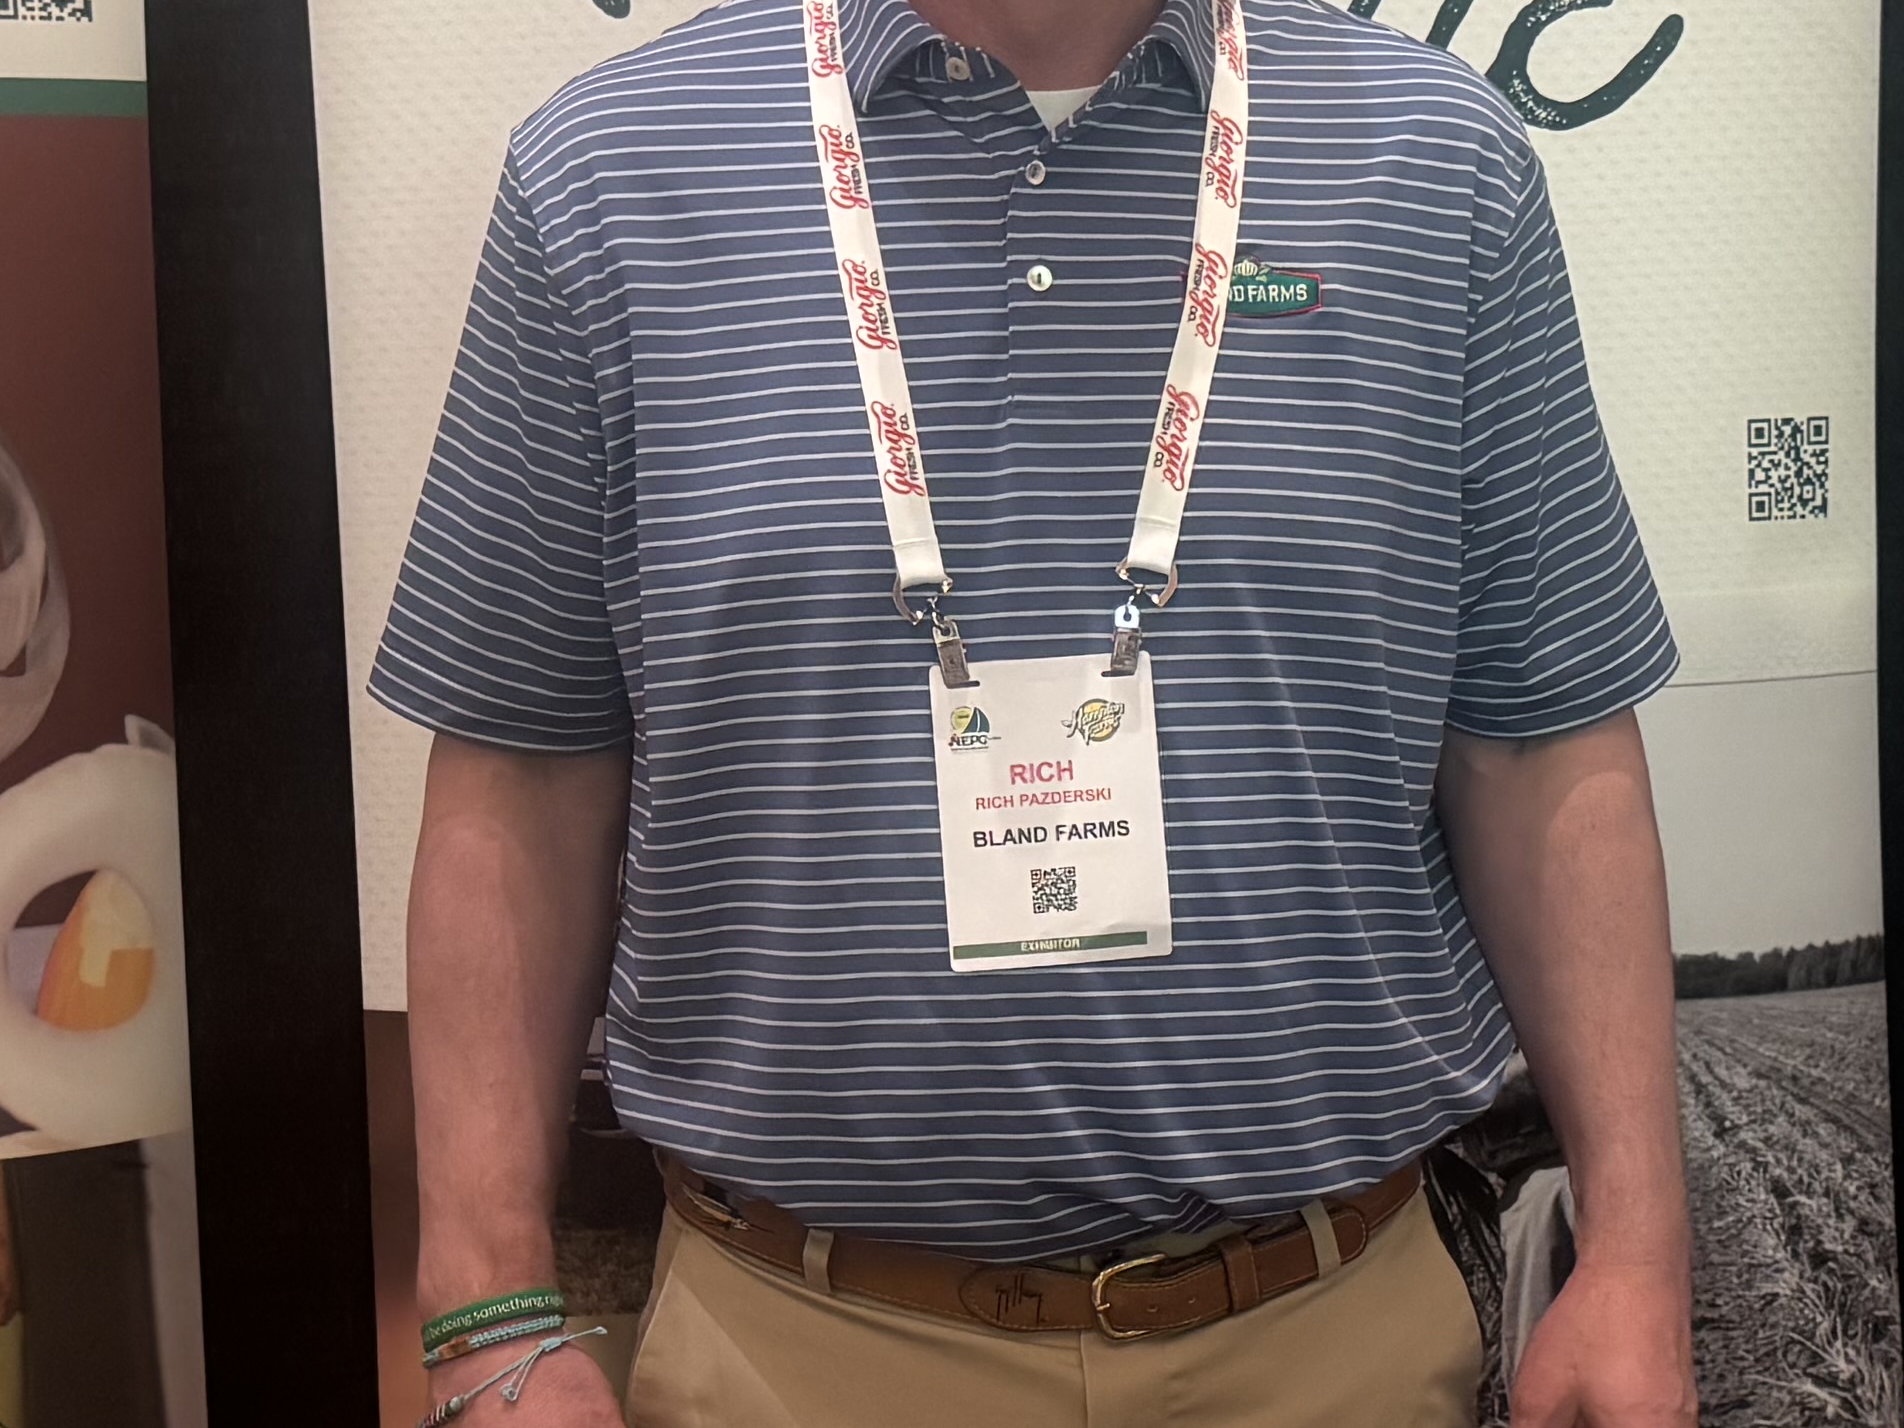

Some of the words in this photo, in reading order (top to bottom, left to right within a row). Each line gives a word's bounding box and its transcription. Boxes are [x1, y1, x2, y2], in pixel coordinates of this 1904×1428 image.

[1248, 284, 1308, 303] FARMS
[1010, 760, 1074, 786] RICH
[976, 794, 1015, 810] RICH
[1019, 787, 1112, 807] PAZDERSKI
[973, 826, 1048, 848] BLAND
[1055, 820, 1130, 843] FARMS
[474, 1296, 545, 1320] something
